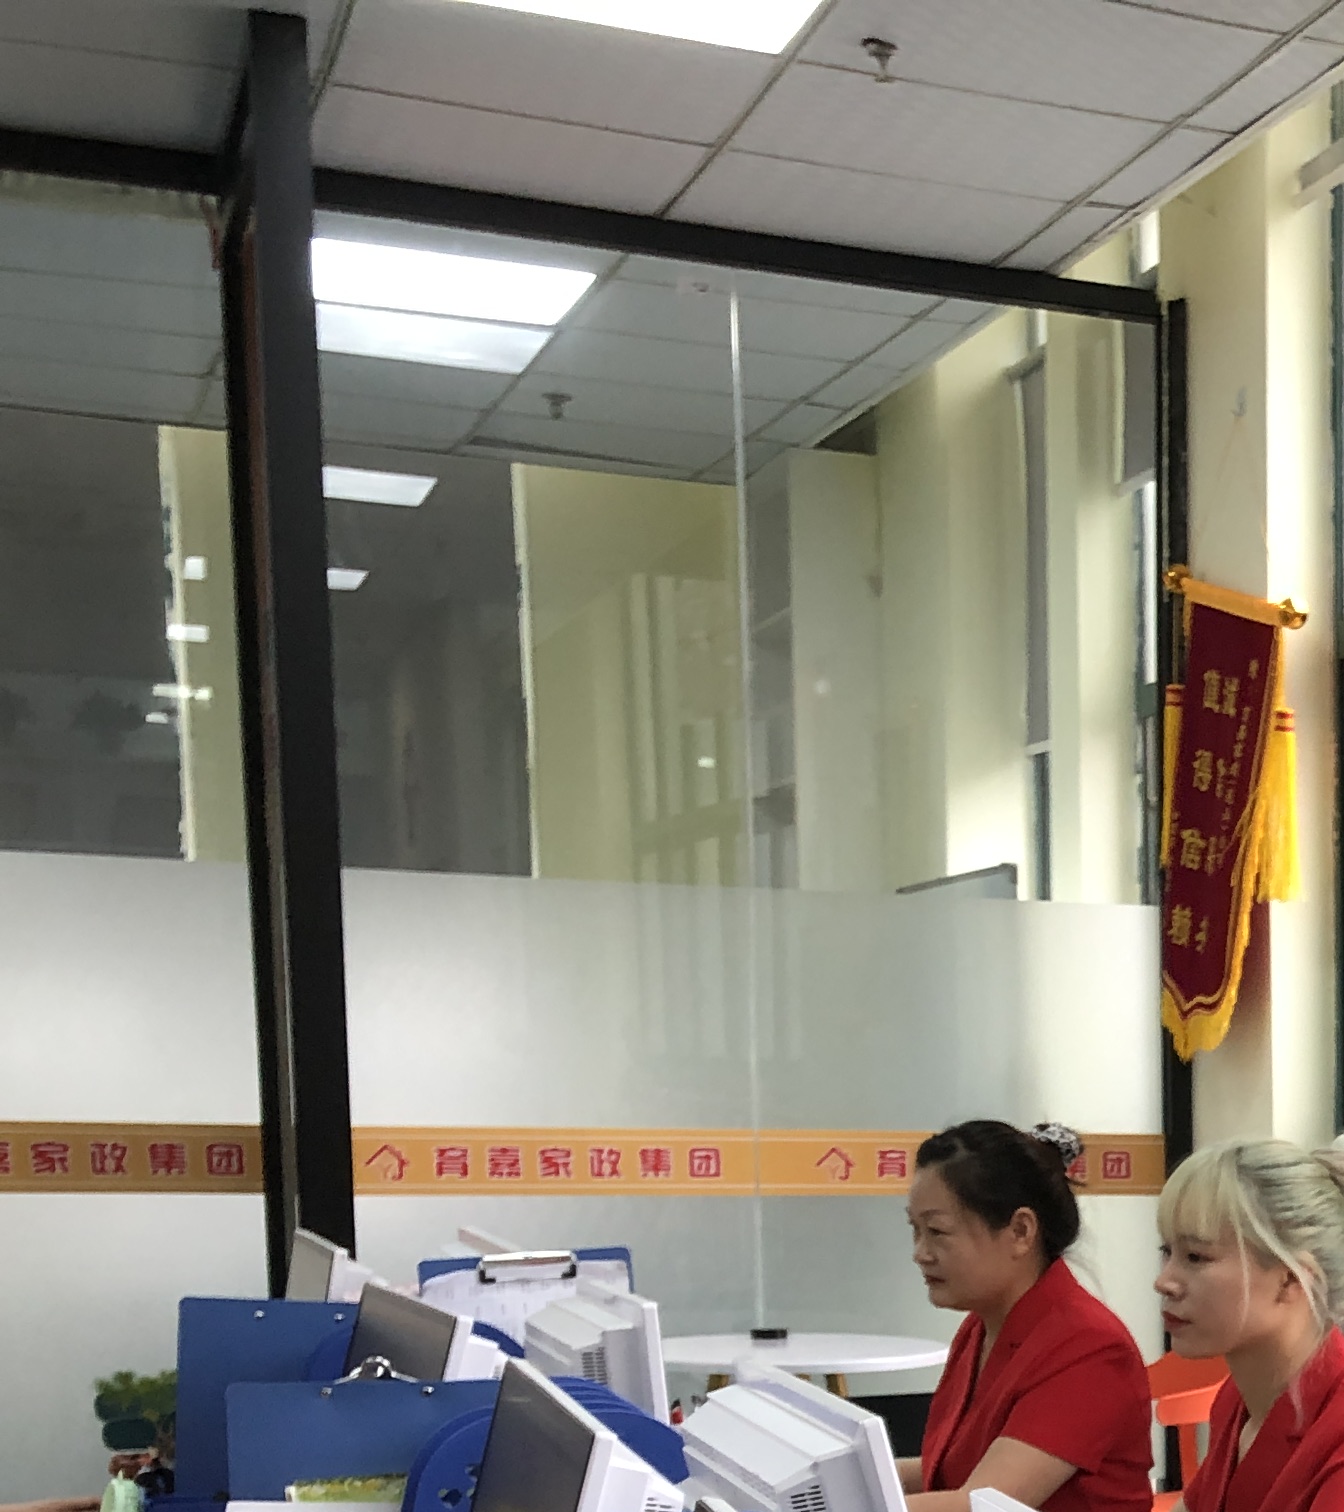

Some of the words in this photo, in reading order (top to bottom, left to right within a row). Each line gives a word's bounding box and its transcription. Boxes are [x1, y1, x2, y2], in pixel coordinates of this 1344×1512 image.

[0, 1142, 246, 1176] 家政集团
[434, 1146, 722, 1179] 育嘉家政集团
